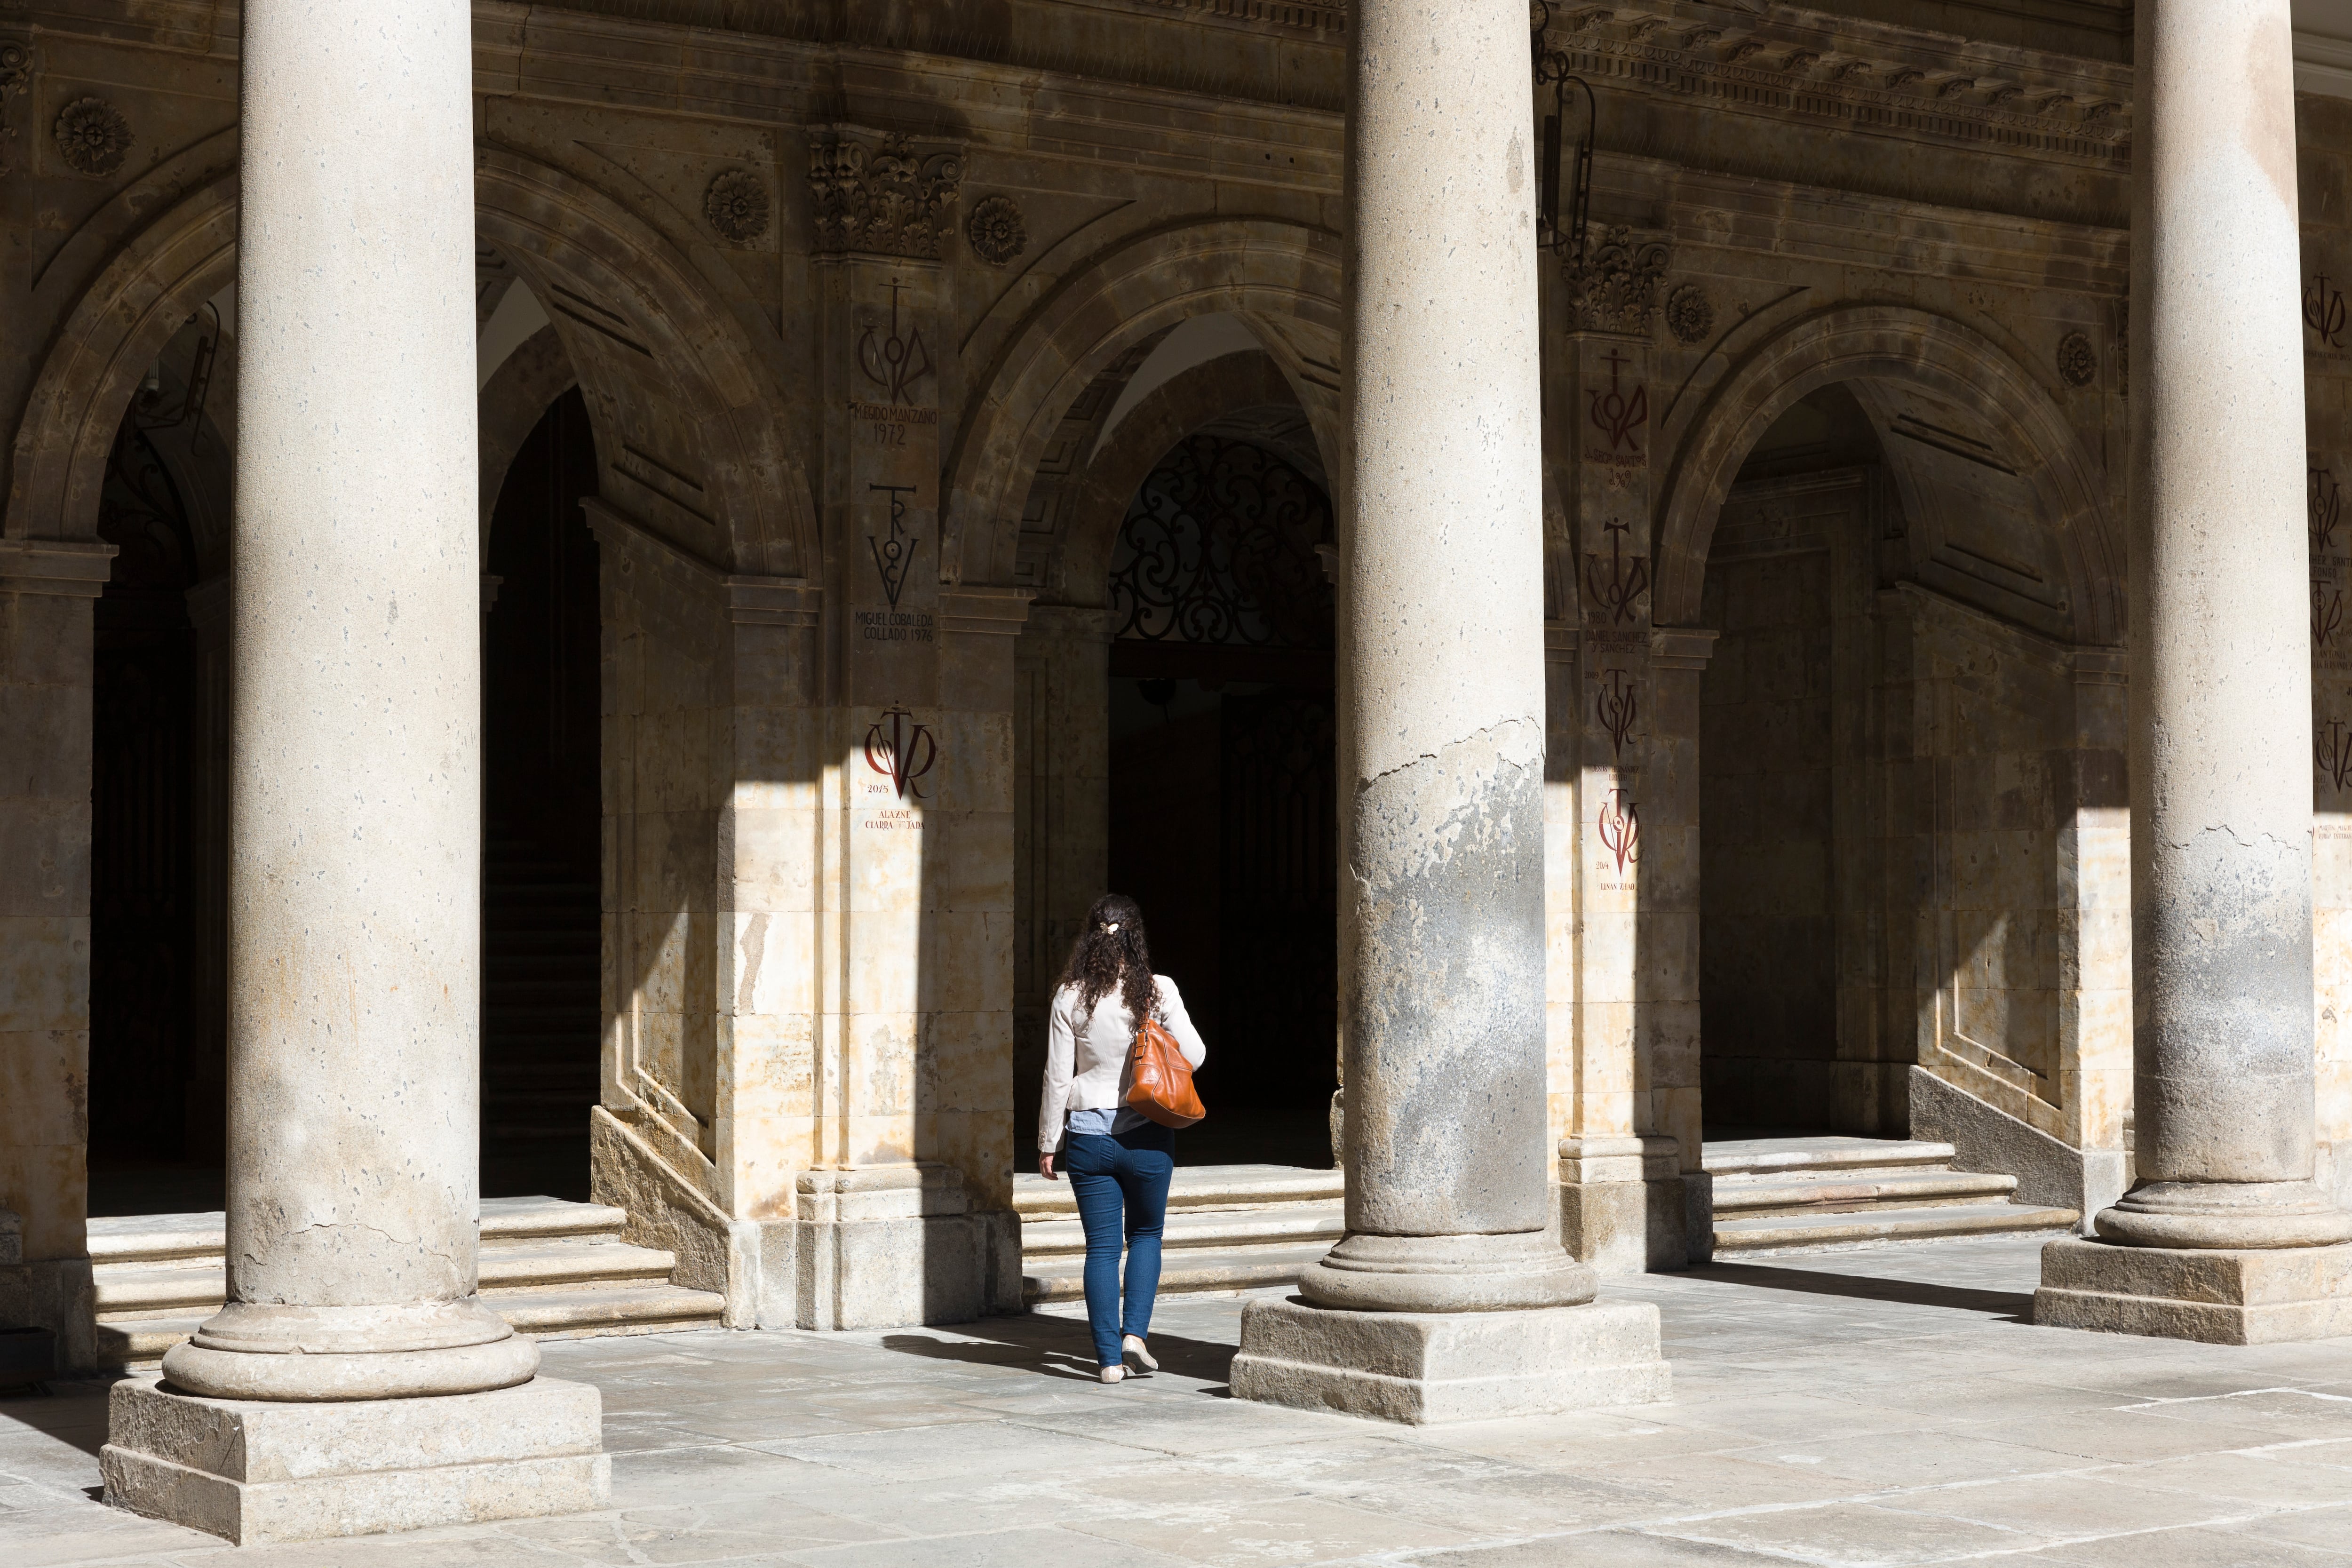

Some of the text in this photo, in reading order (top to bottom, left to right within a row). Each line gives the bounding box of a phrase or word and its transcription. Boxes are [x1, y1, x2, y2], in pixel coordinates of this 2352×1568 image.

[873, 422, 906, 445] 1972
[1615, 454, 1647, 468] SANTOS
[855, 612, 933, 627] MIGUEL COBALEDA
[1588, 611, 1607, 625] 1980
[864, 626, 933, 642] COLLADO 1976
[1586, 629, 1647, 643] DANIEL SANCHEZ
[1600, 643, 1636, 654] SANCHEZ
[1584, 670, 1599, 679] 2009
[867, 783, 889, 794] 2015
[878, 810, 911, 819] ALAZNE
